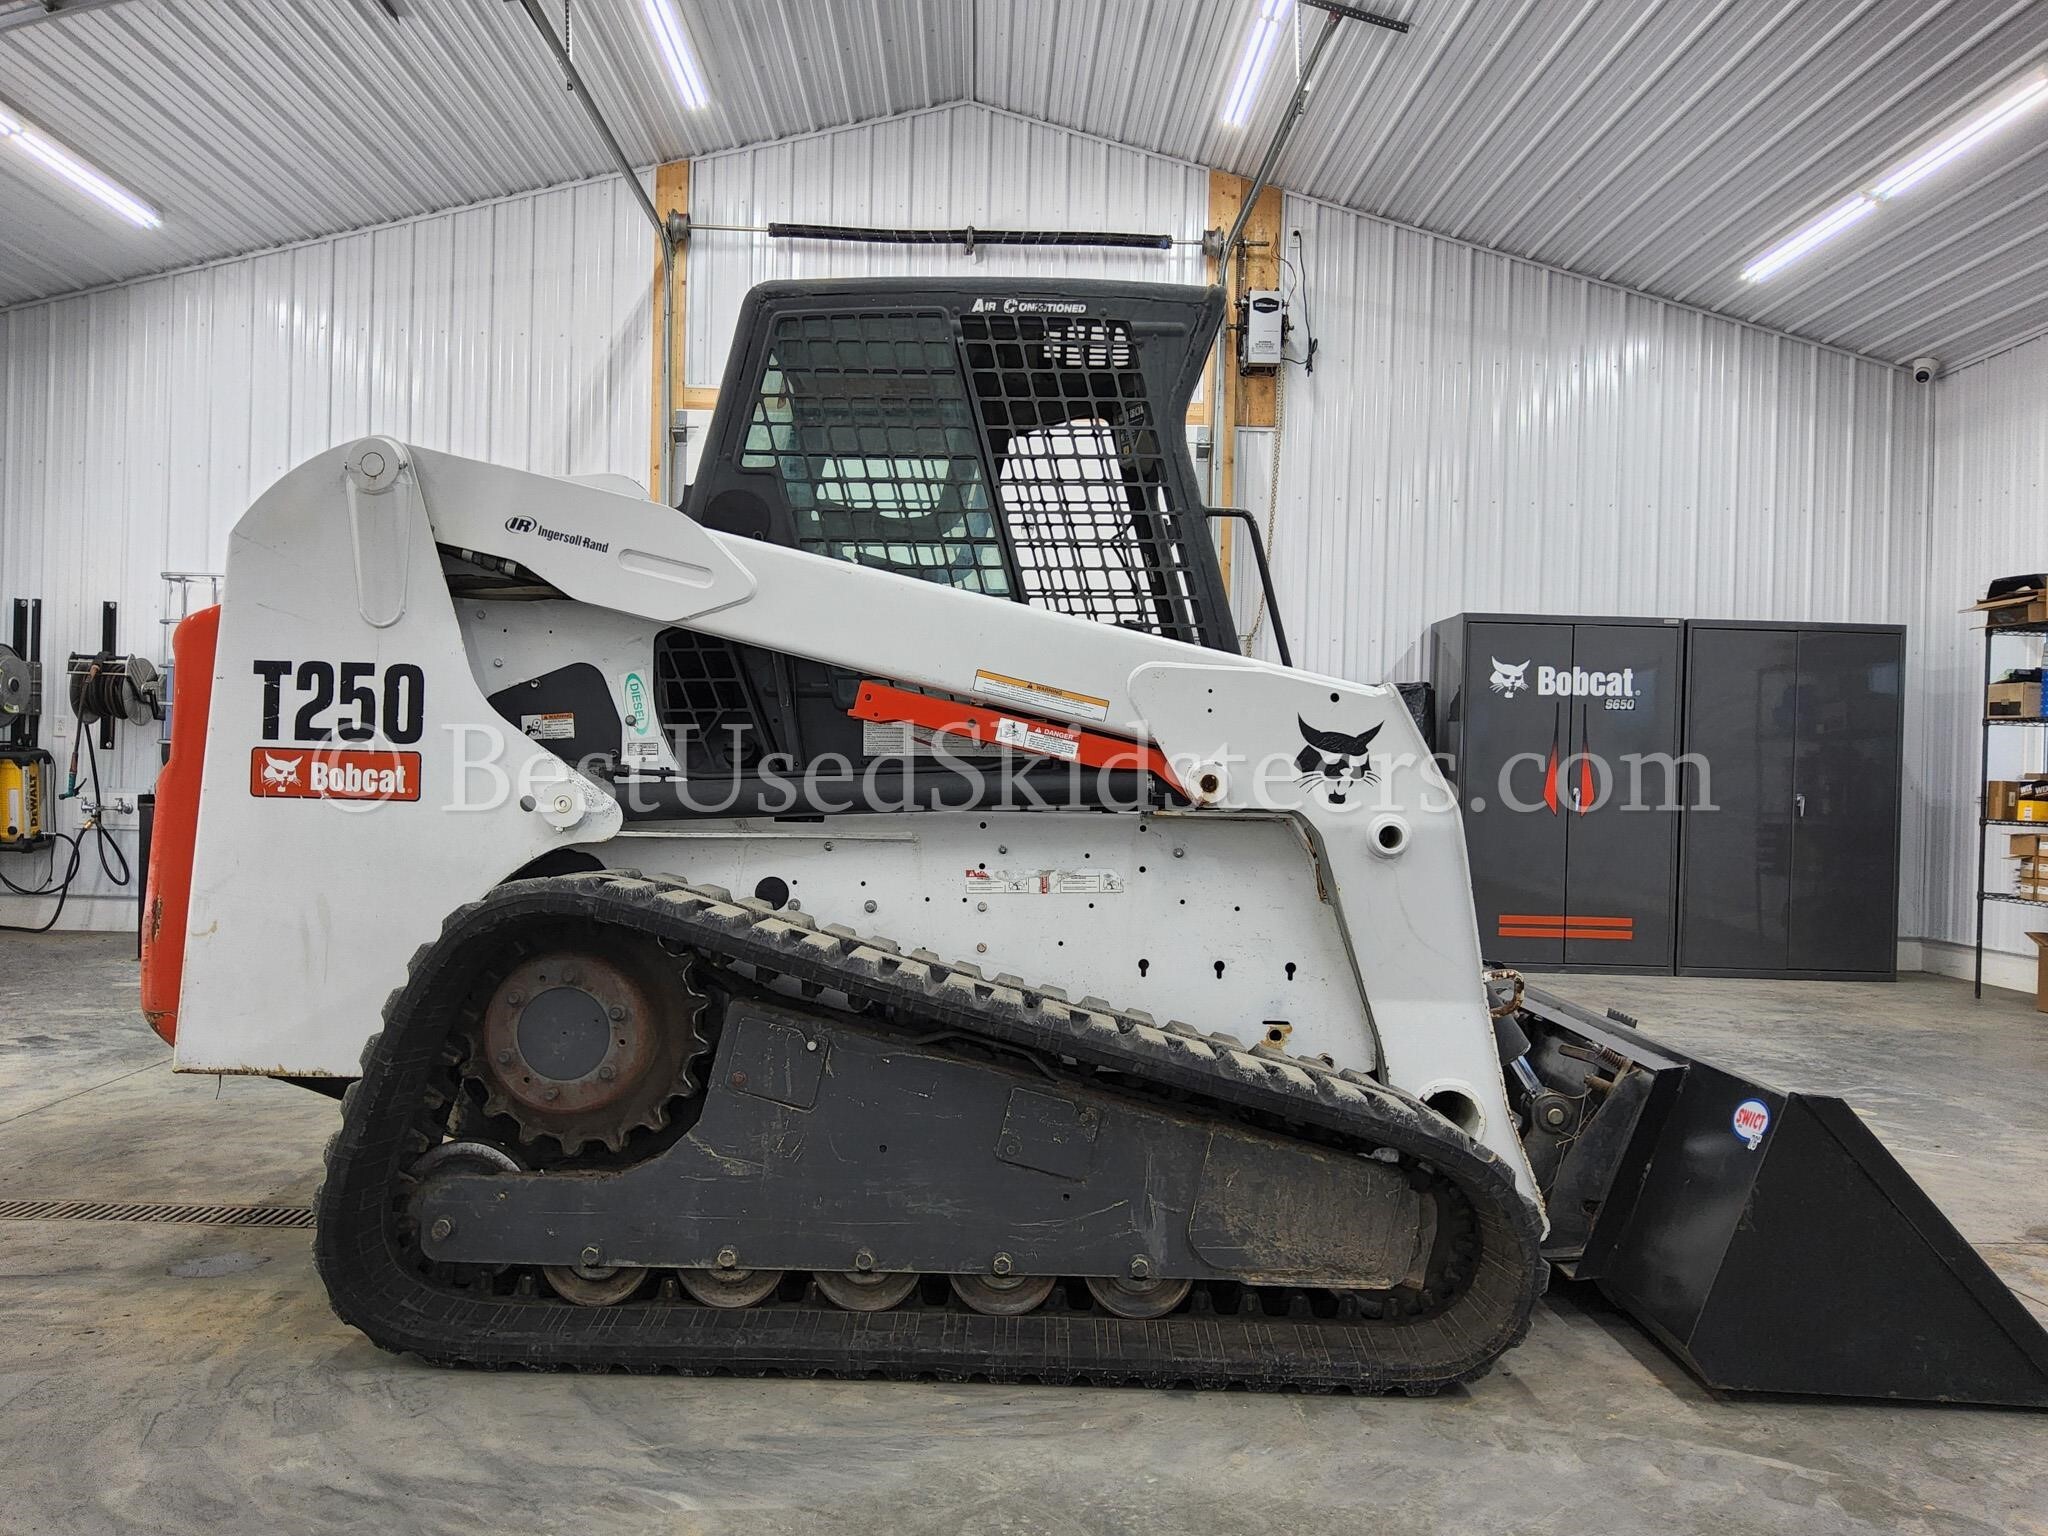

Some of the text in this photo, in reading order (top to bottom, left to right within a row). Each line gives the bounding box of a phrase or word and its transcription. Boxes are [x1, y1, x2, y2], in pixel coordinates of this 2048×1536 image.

[1036, 685, 1063, 696] WARNING
[1537, 666, 1634, 697] Bobcat
[253, 659, 425, 745] T250
[629, 683, 645, 726] DIESEL
[1604, 700, 1635, 710] S650
[1043, 728, 1074, 741] DANGER
[310, 761, 406, 793] Bobcat
[1736, 1108, 1766, 1131] SWICT
